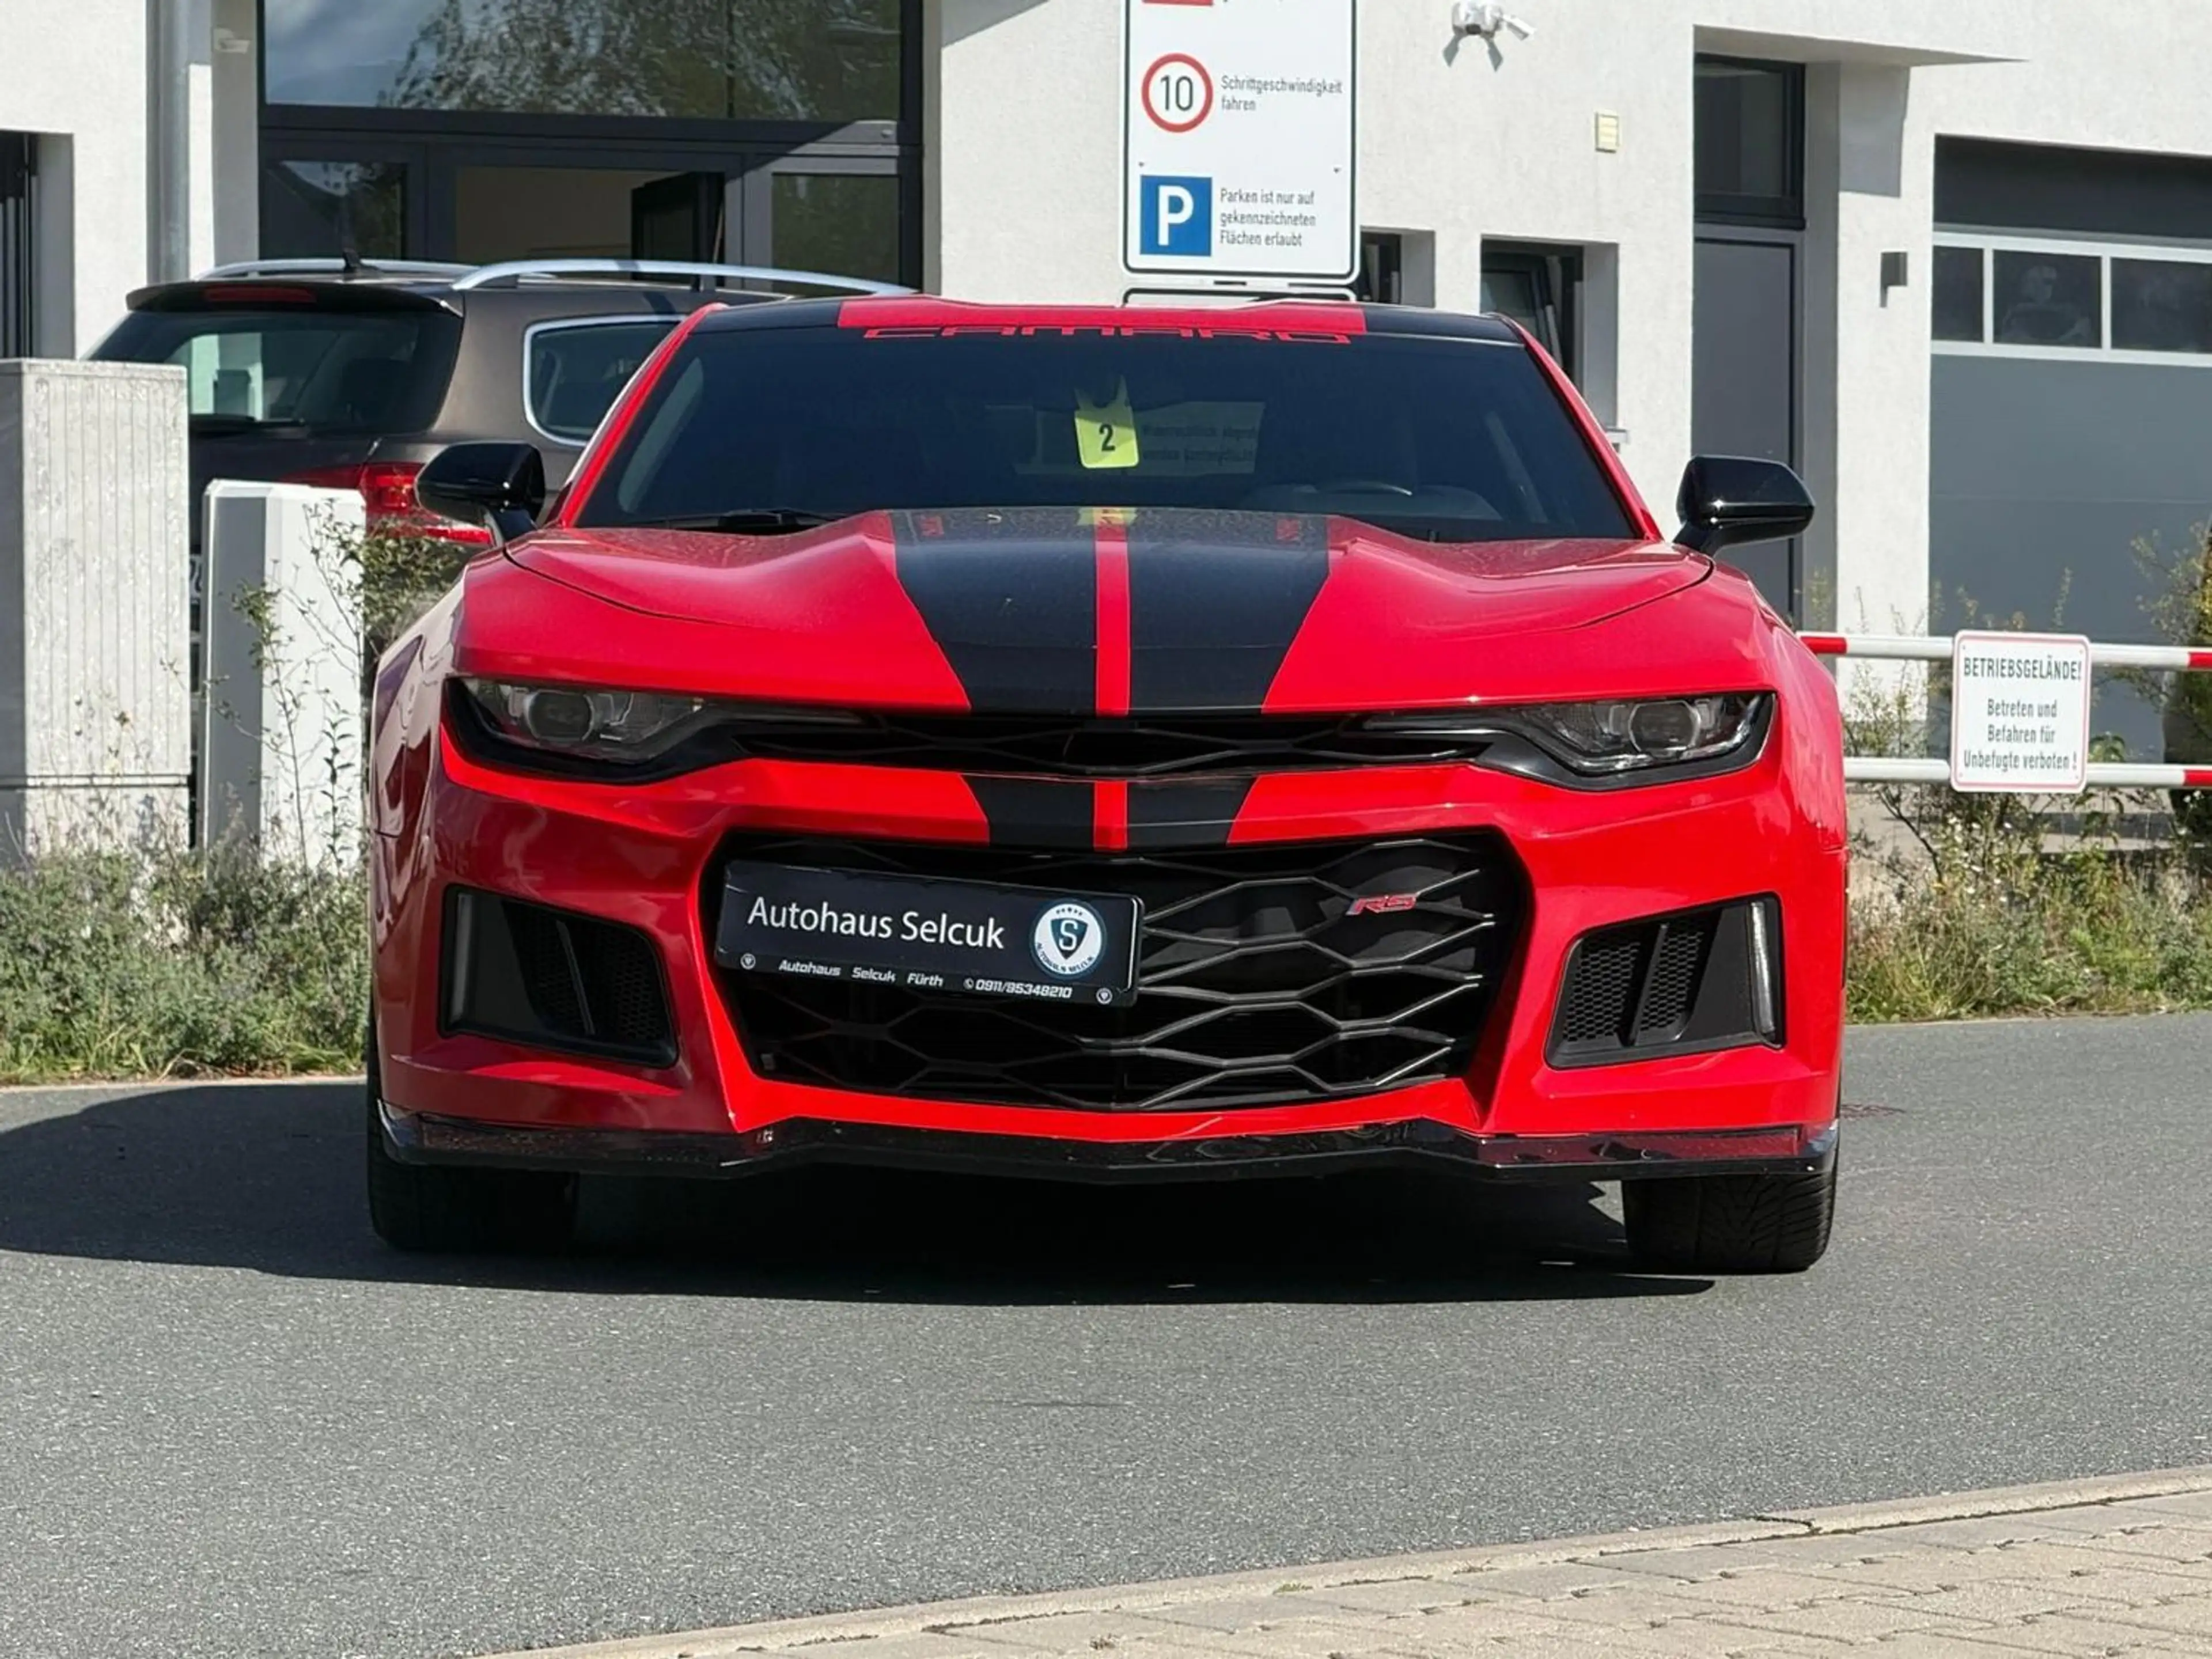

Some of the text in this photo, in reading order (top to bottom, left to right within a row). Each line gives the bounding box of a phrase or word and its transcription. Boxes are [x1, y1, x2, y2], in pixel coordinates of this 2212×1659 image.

[1160, 75, 1194, 111] 10
[1221, 75, 1343, 97] Schrittgeschwindigkeit
[1221, 96, 1256, 111] fahren
[1220, 188, 1315, 204] Parken ist nur auf
[1157, 185, 1194, 246] P
[1220, 209, 1316, 227] gekennzeichneten
[1220, 229, 1302, 247] Flächen erlaubt
[1099, 424, 1115, 452] 2
[1963, 655, 2082, 680] BETRIEBSGELÄNDE!
[1987, 698, 2057, 717] Betreten und
[1987, 725, 2055, 743] Befahren für
[1964, 750, 2020, 772] Unbefugte
[2023, 752, 2069, 770] verboten
[1346, 893, 1416, 915] RS
[747, 896, 1005, 949] Autohaus Selcuk
[1059, 920, 1078, 950] S
[779, 959, 944, 987] Autohaus Selcuk Fürth
